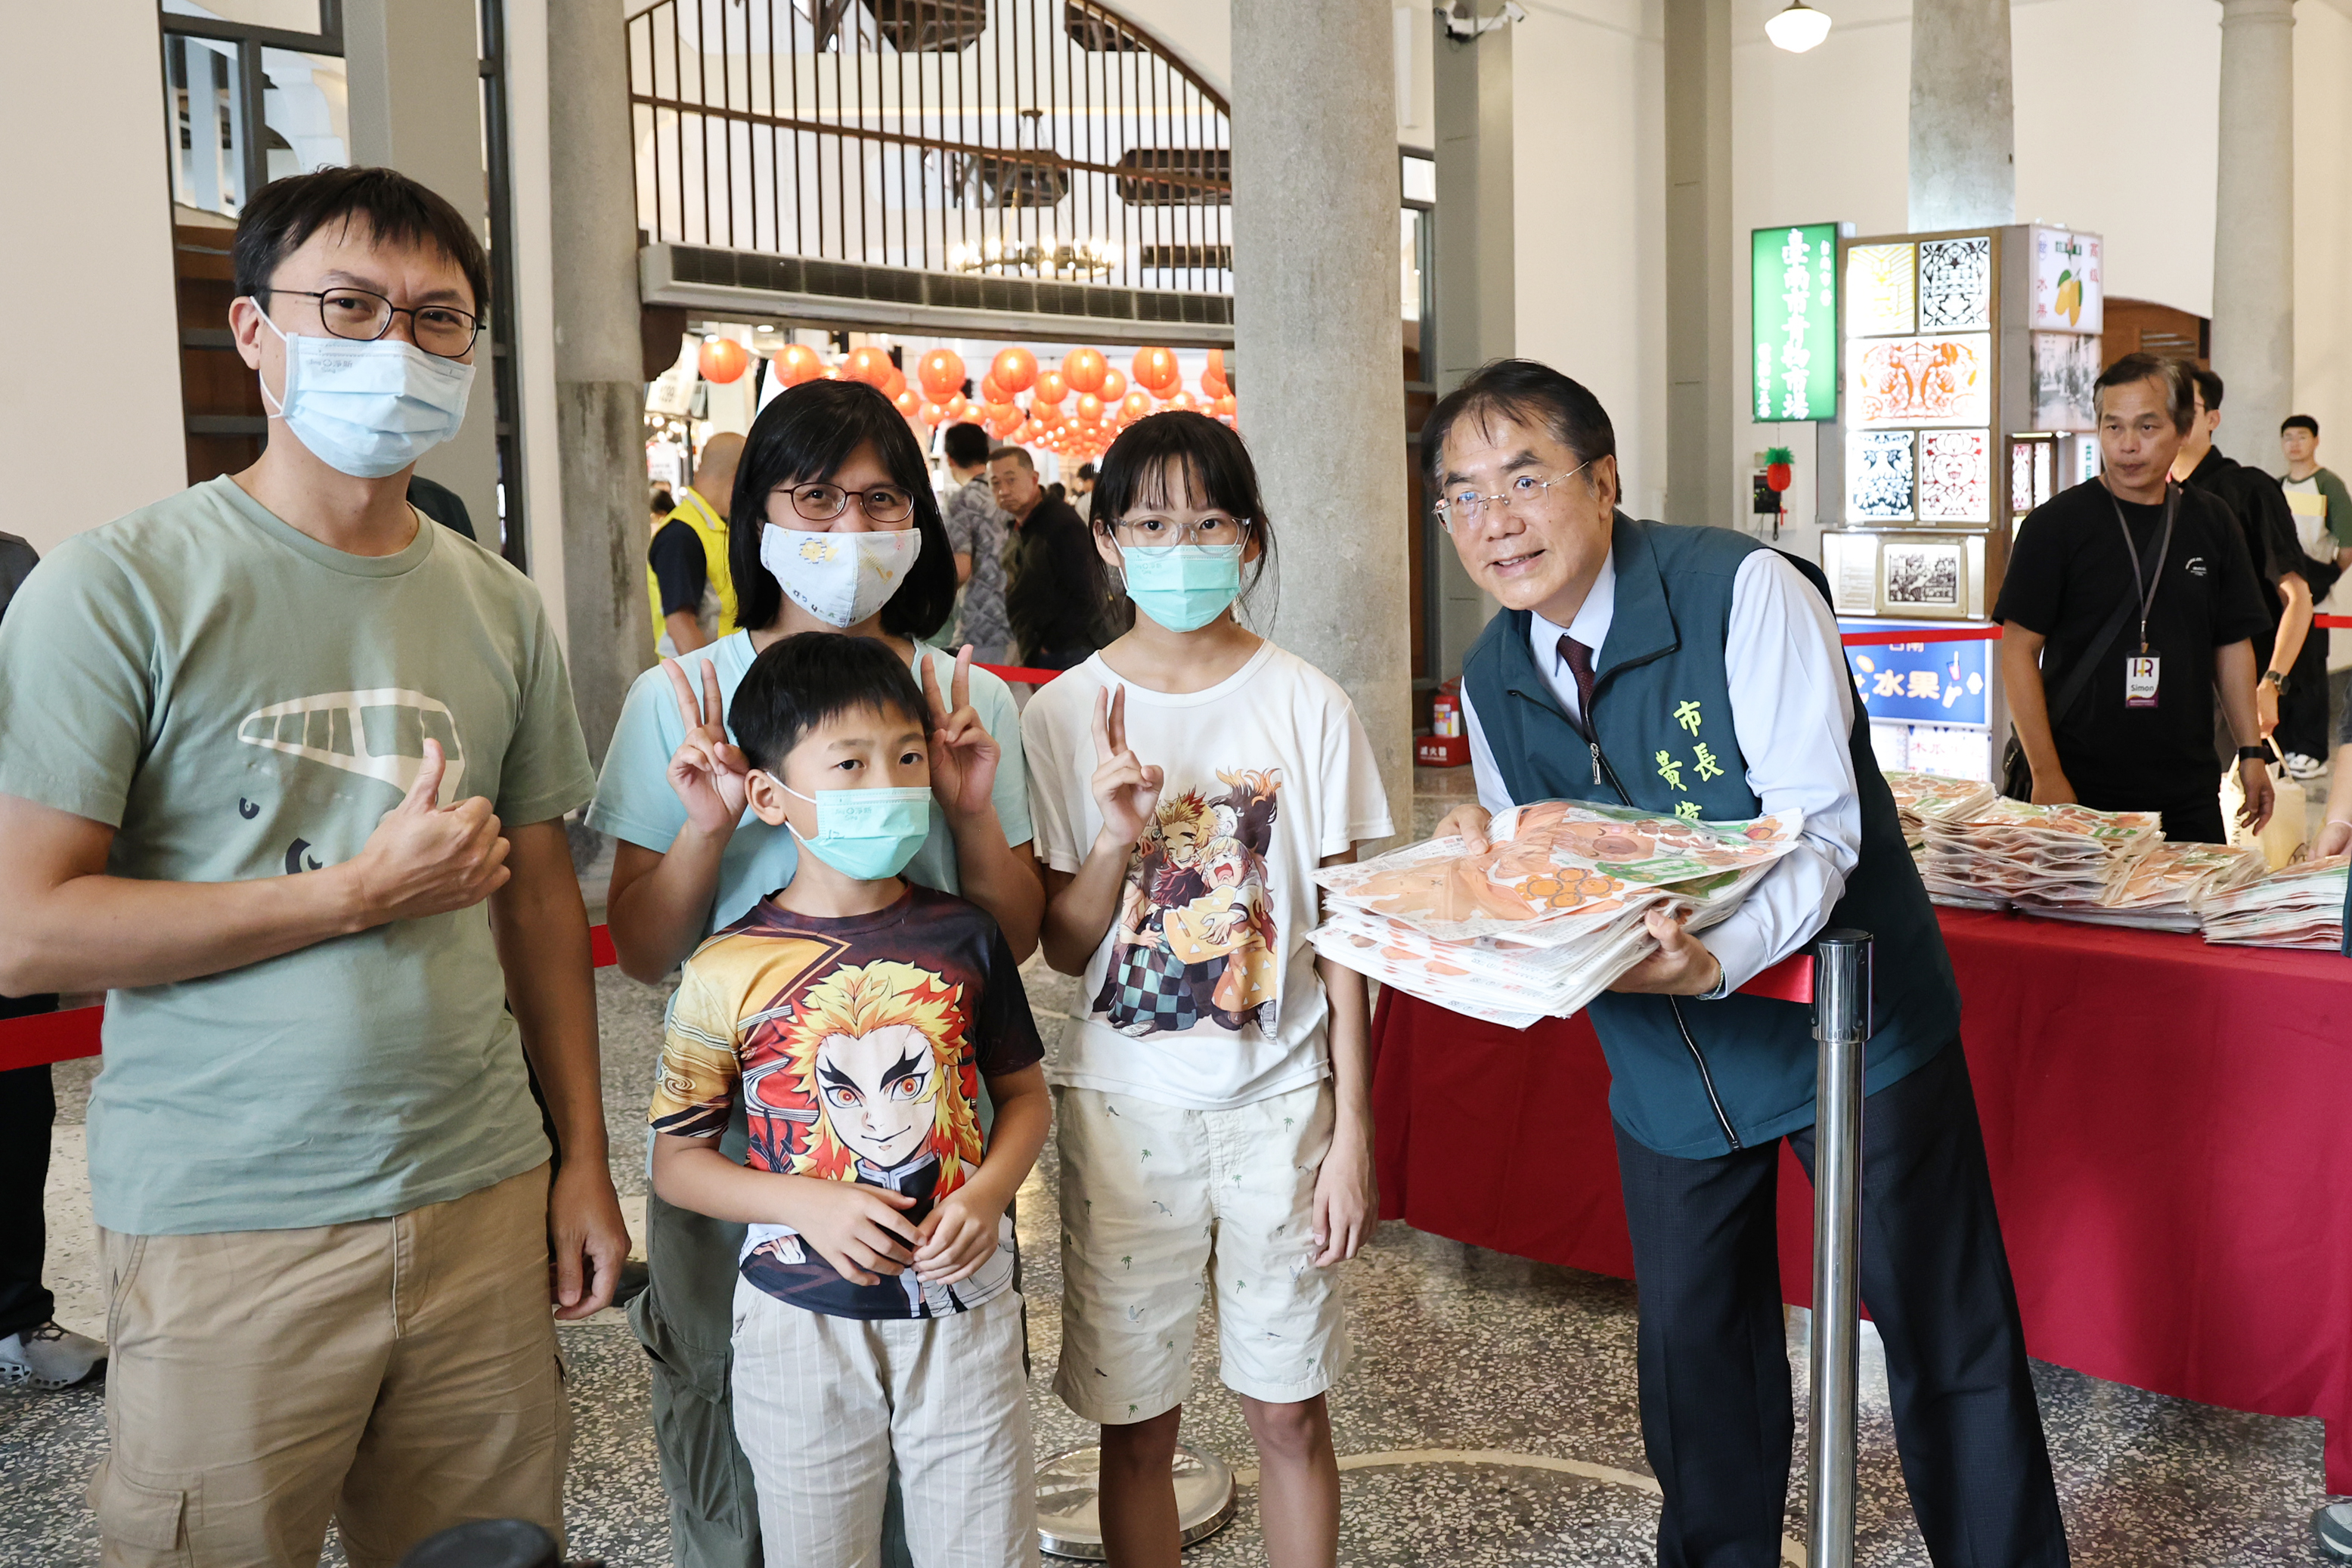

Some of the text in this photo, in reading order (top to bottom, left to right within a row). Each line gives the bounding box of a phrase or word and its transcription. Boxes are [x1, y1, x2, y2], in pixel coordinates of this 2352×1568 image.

[2090, 243, 2099, 283] 高級
[2036, 277, 2047, 318] 水果
[1872, 669, 1941, 699] 水果
[1673, 700, 1724, 782] 市長
